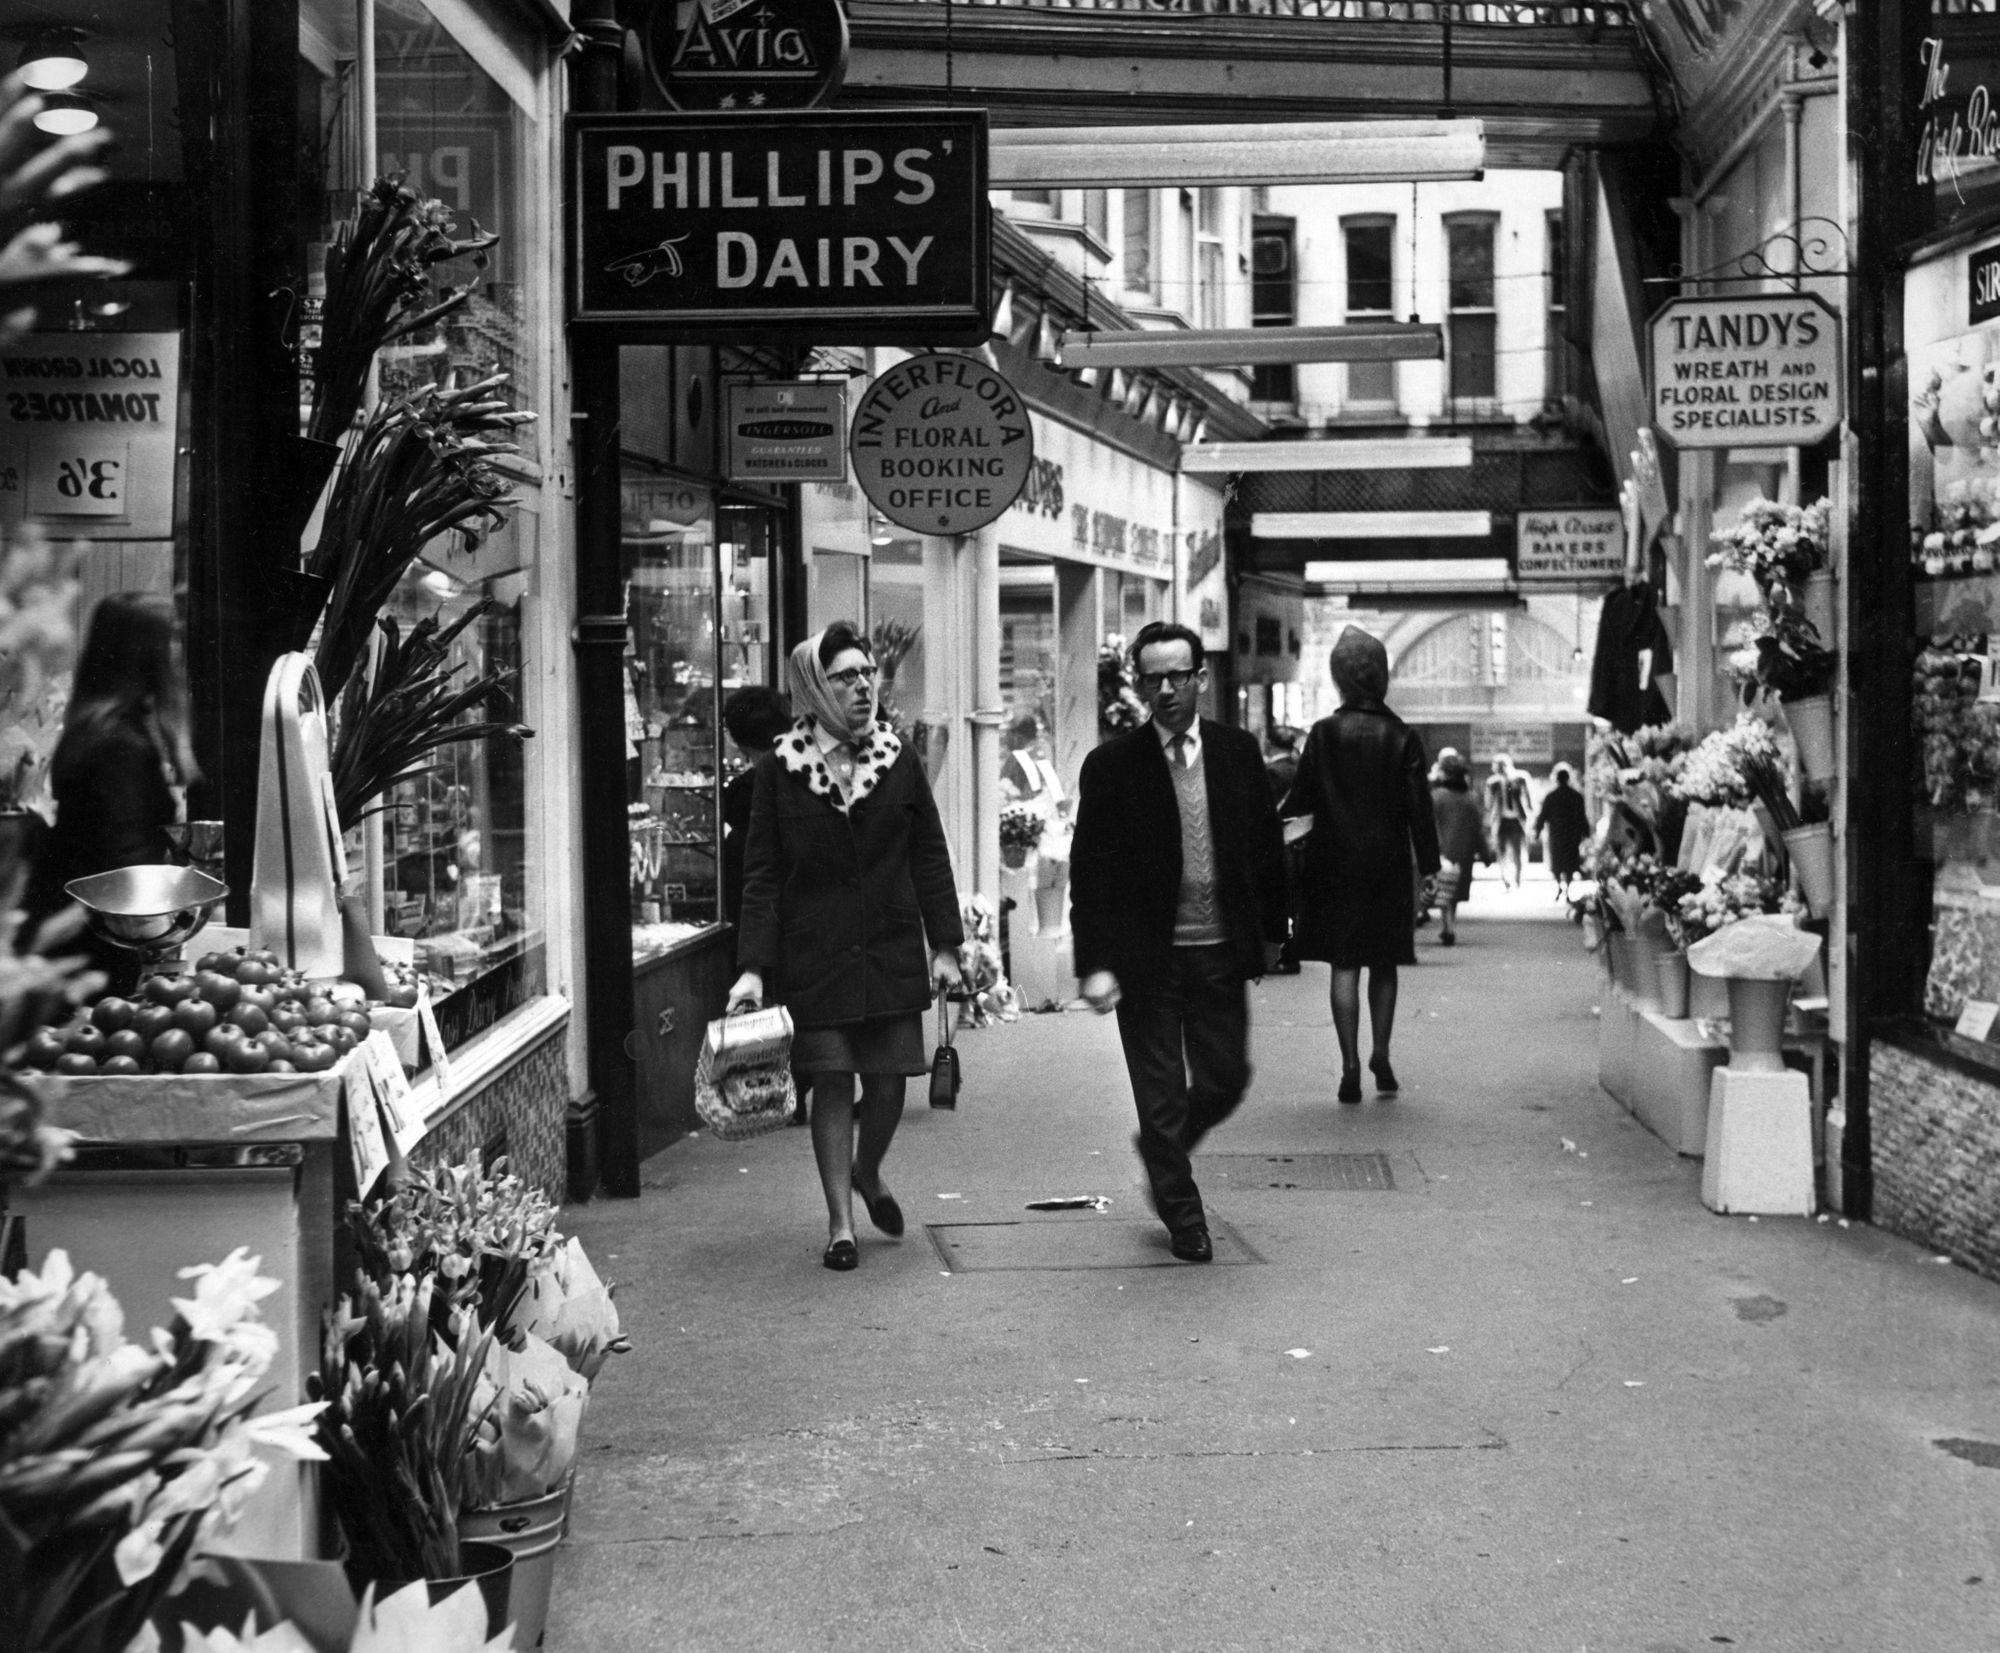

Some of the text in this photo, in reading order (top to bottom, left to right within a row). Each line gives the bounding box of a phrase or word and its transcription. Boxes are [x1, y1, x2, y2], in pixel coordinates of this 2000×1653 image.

[671, 5, 819, 68] Avia
[607, 139, 953, 210] PHILLIPS'
[717, 231, 934, 289] DAIRY
[1674, 359, 1816, 380] WREATH AND
[1660, 382, 1829, 405] FLORAL DESIGN
[857, 361, 1026, 449] INTERFLORA
[920, 396, 960, 420] And
[745, 424, 831, 436] INGERSOLL
[894, 427, 990, 448] FLORAL
[745, 459, 786, 468] WATCHES
[794, 458, 828, 468] CLOCKS
[880, 457, 1004, 478] BOOKING
[888, 488, 992, 509] OFFICE
[1525, 517, 1558, 538] High
[1532, 541, 1606, 554] BAKERS
[1518, 558, 1622, 571] CONFECTIONERS
[465, 988, 496, 1036] Dairy
